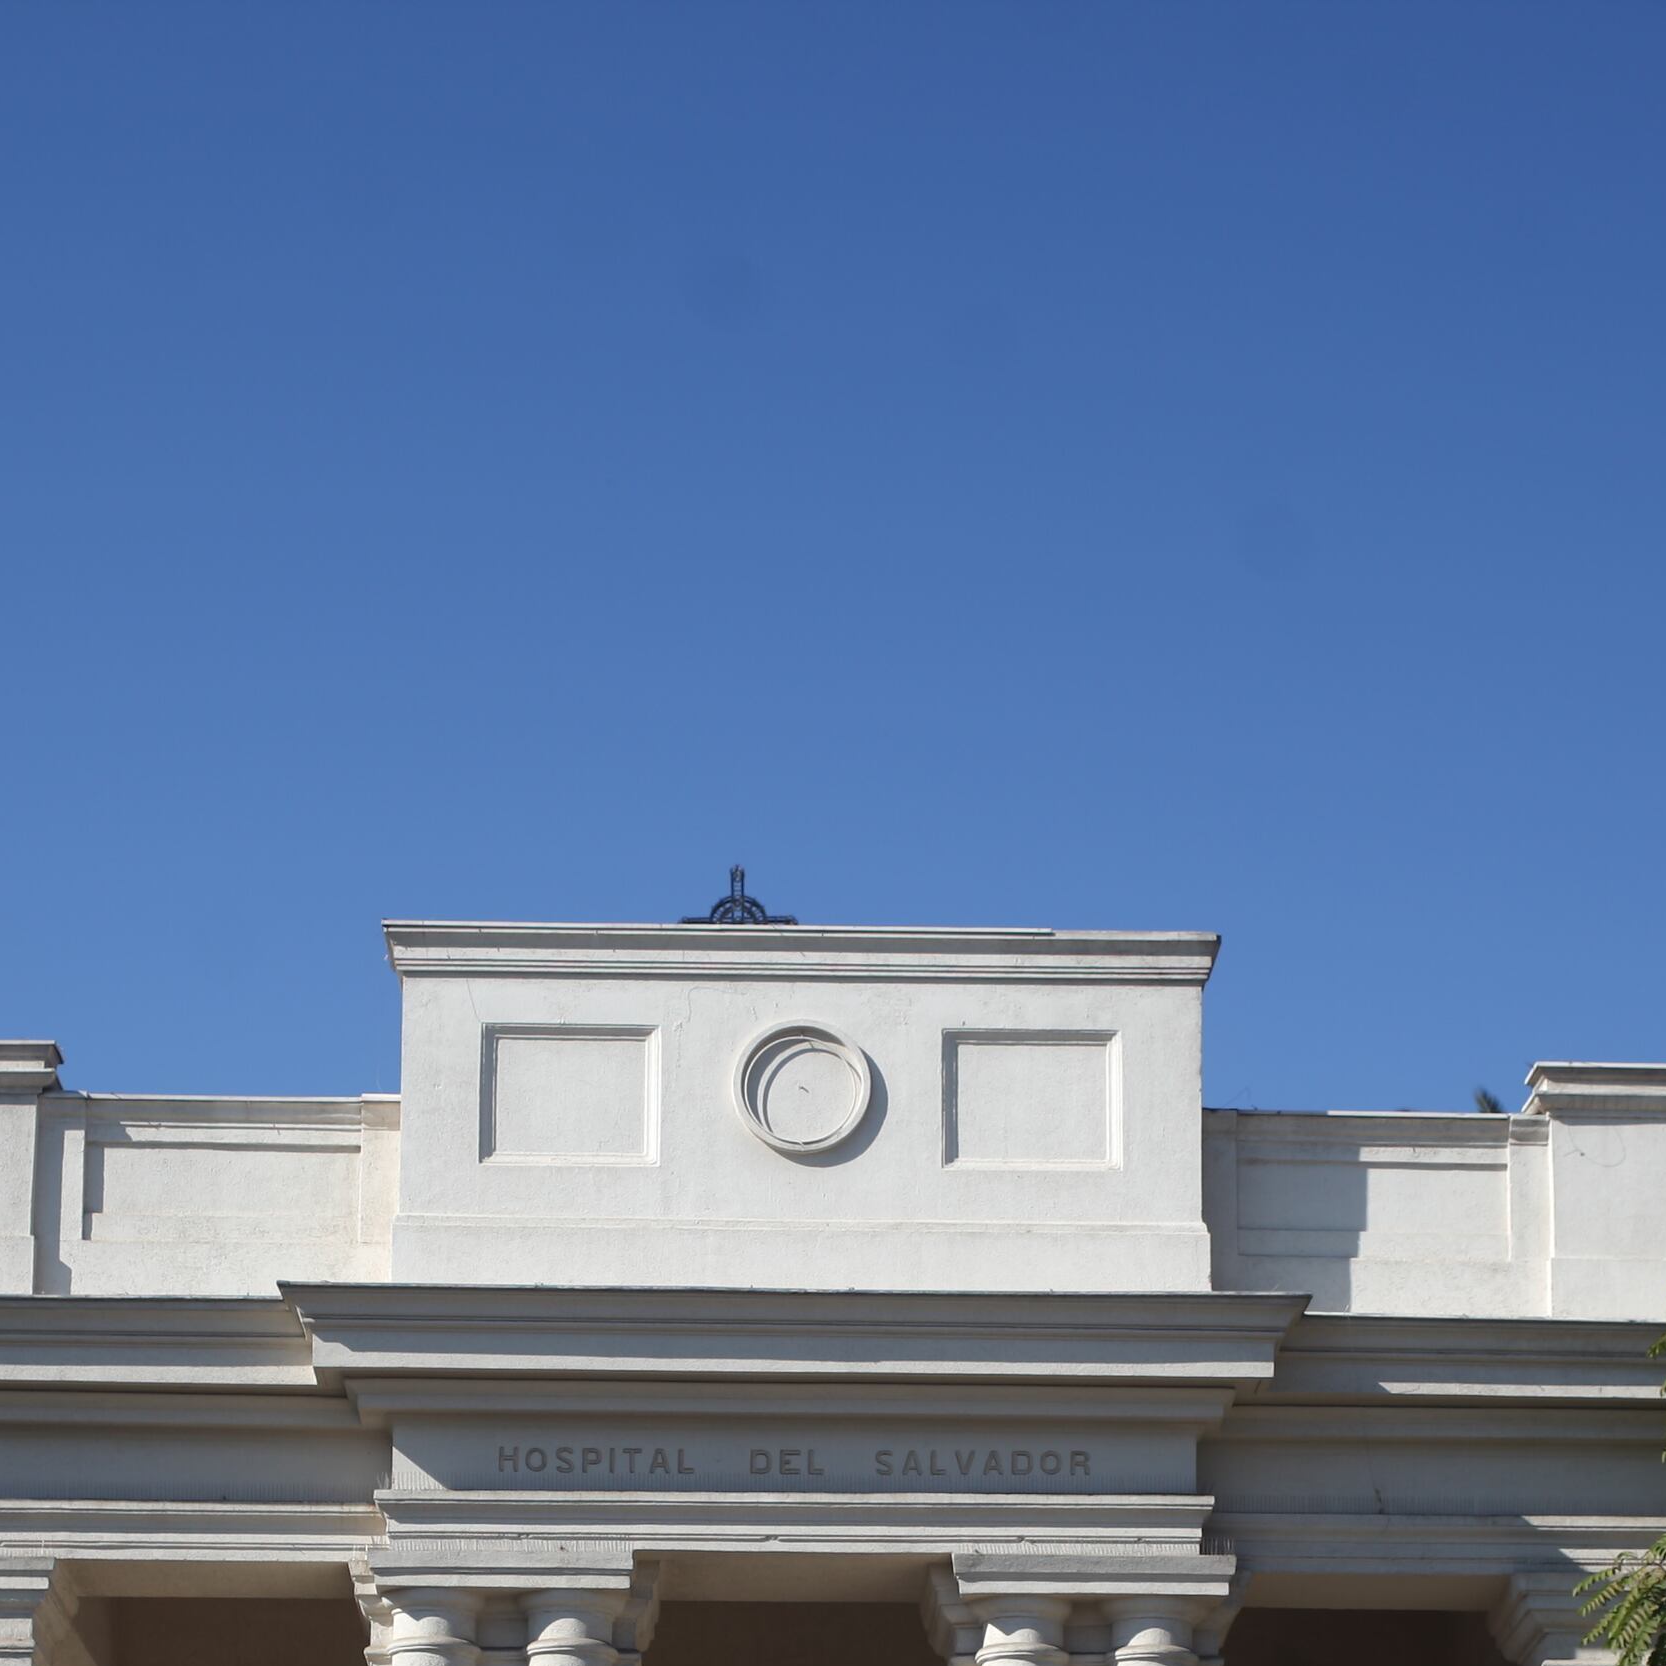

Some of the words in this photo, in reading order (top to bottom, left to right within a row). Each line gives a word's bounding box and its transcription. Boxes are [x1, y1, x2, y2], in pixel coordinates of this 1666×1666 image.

[497, 1446, 695, 1475] HOSPITAL
[749, 1448, 825, 1476] DEL
[874, 1449, 1093, 1477] SALVADOR
